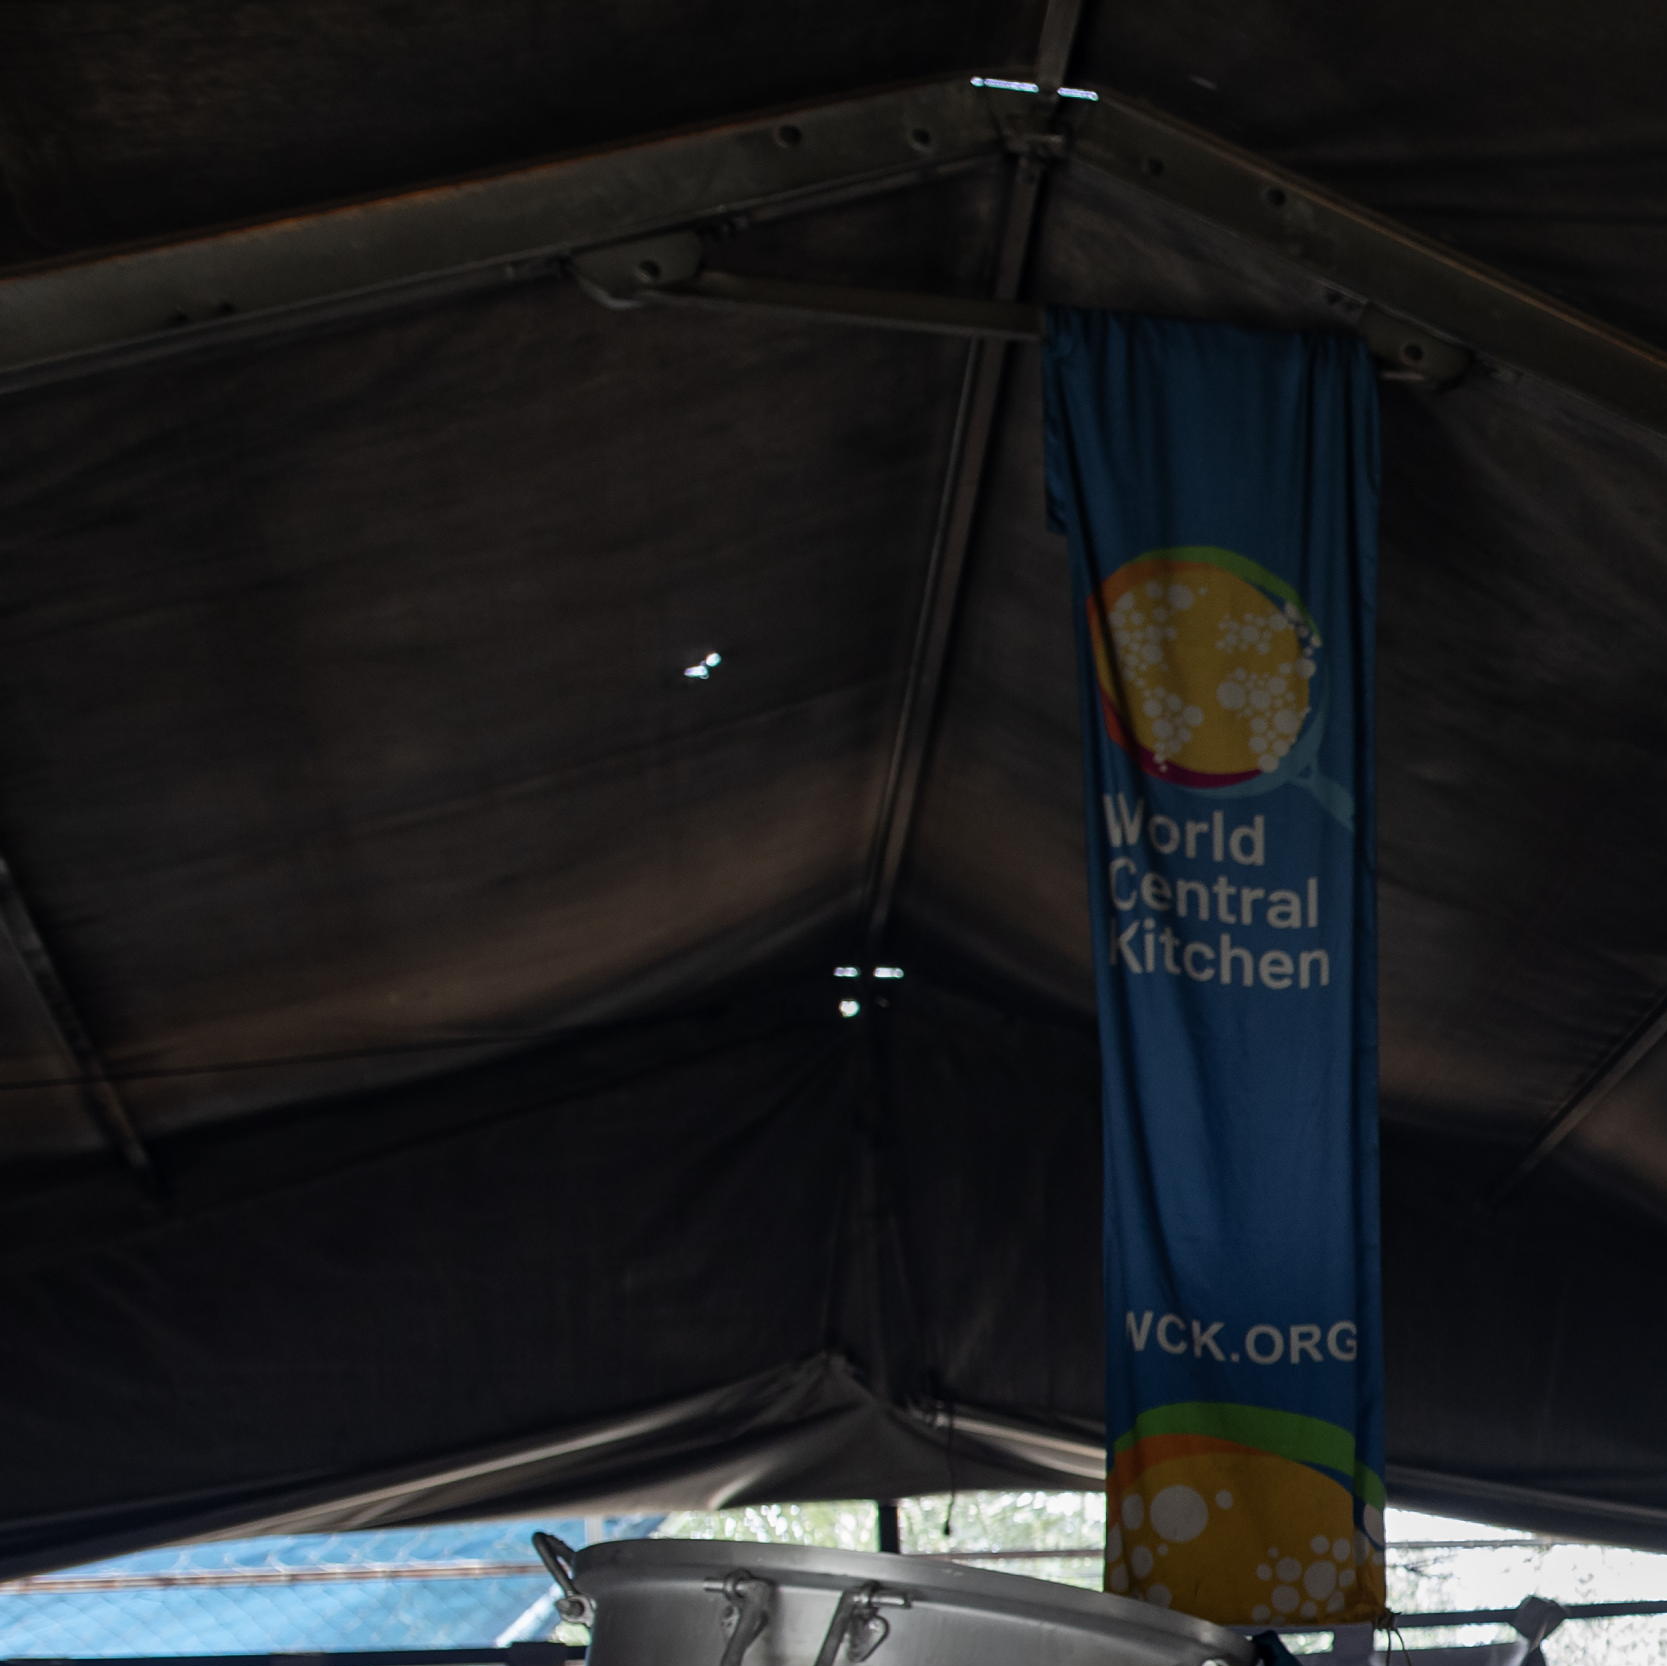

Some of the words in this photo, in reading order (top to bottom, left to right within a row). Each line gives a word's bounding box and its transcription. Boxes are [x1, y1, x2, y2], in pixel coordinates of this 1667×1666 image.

[1102, 791, 1266, 867] World
[1108, 856, 1320, 930] Central
[1109, 918, 1331, 990] Kitchen
